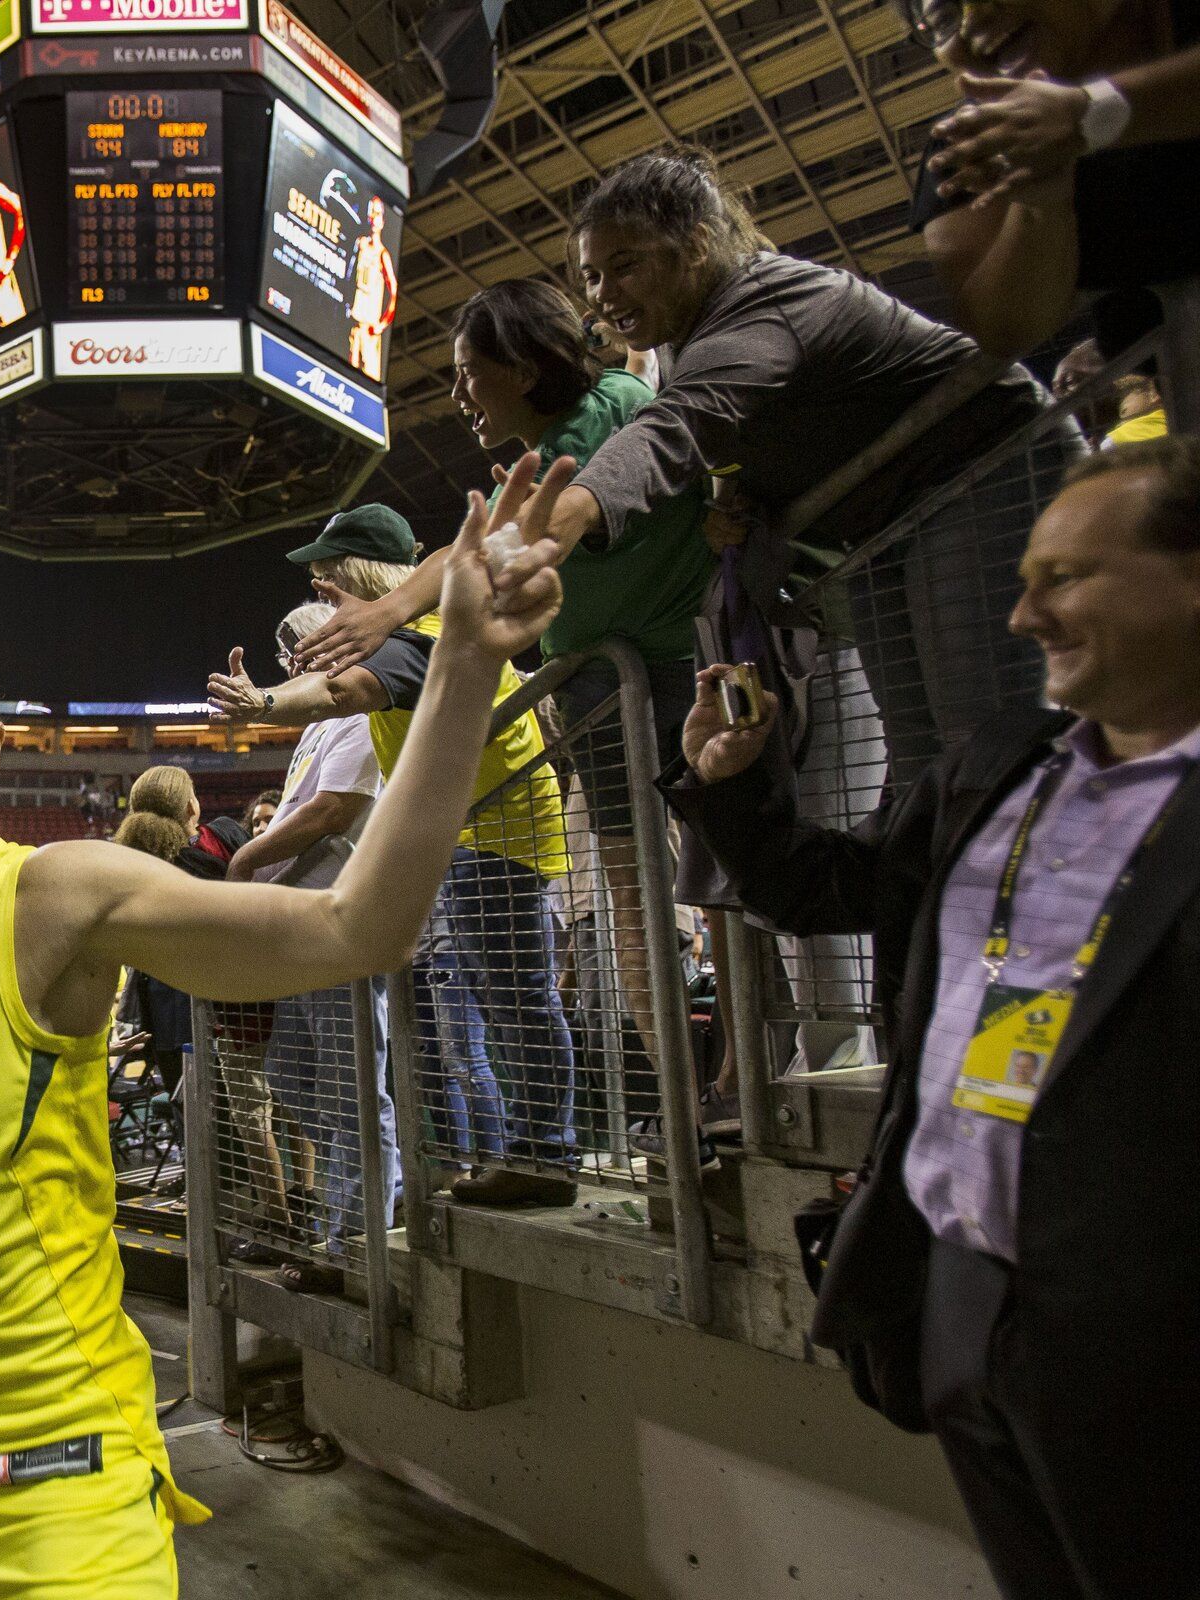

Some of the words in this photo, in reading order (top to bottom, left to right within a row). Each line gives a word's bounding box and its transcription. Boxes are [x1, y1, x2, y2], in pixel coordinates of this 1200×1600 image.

[95, 138, 122, 157] 94
[172, 138, 199, 158] 84
[286, 187, 341, 244] SEATTLE
[69, 338, 148, 365] Coors
[296, 366, 354, 413] Alaska
